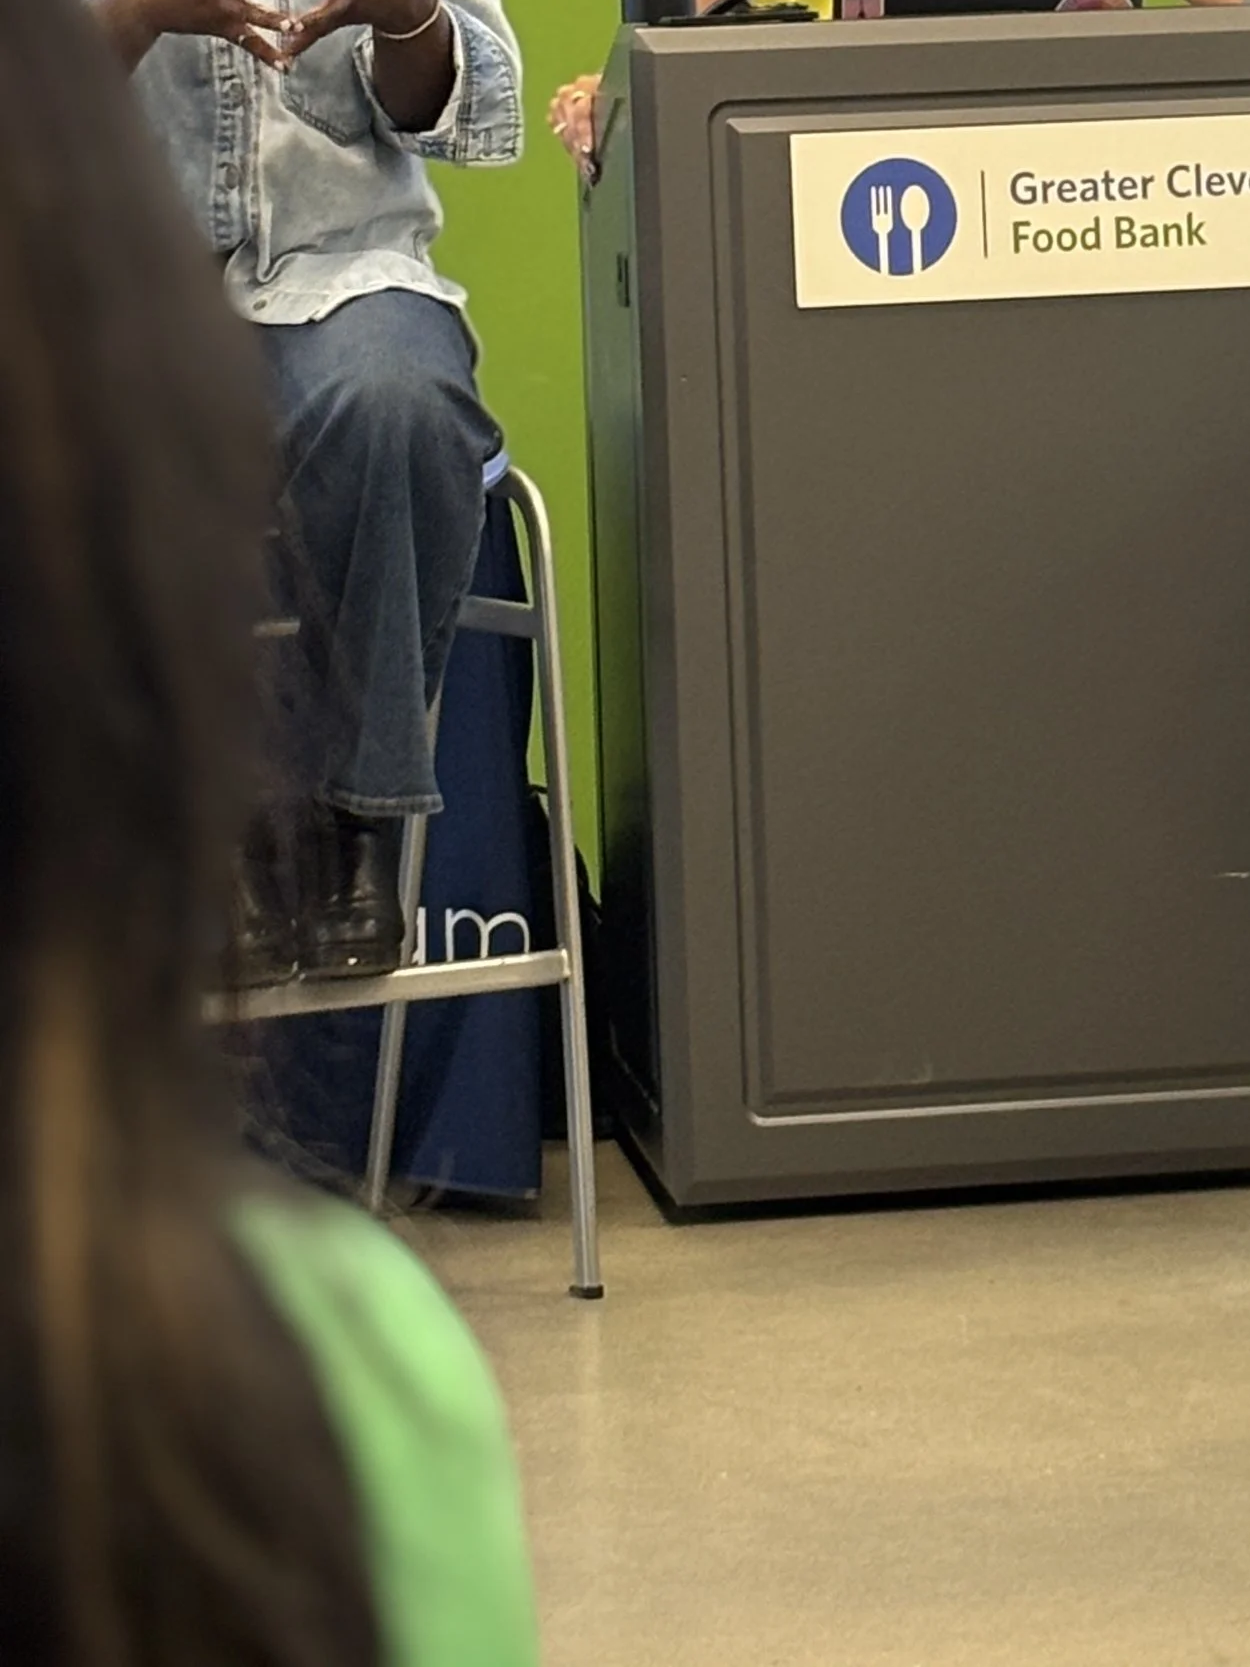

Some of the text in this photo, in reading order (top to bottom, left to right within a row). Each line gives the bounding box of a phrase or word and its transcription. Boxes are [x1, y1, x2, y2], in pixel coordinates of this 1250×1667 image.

[1010, 170, 1155, 207] Greater
[1012, 212, 1207, 255] Food Bank
